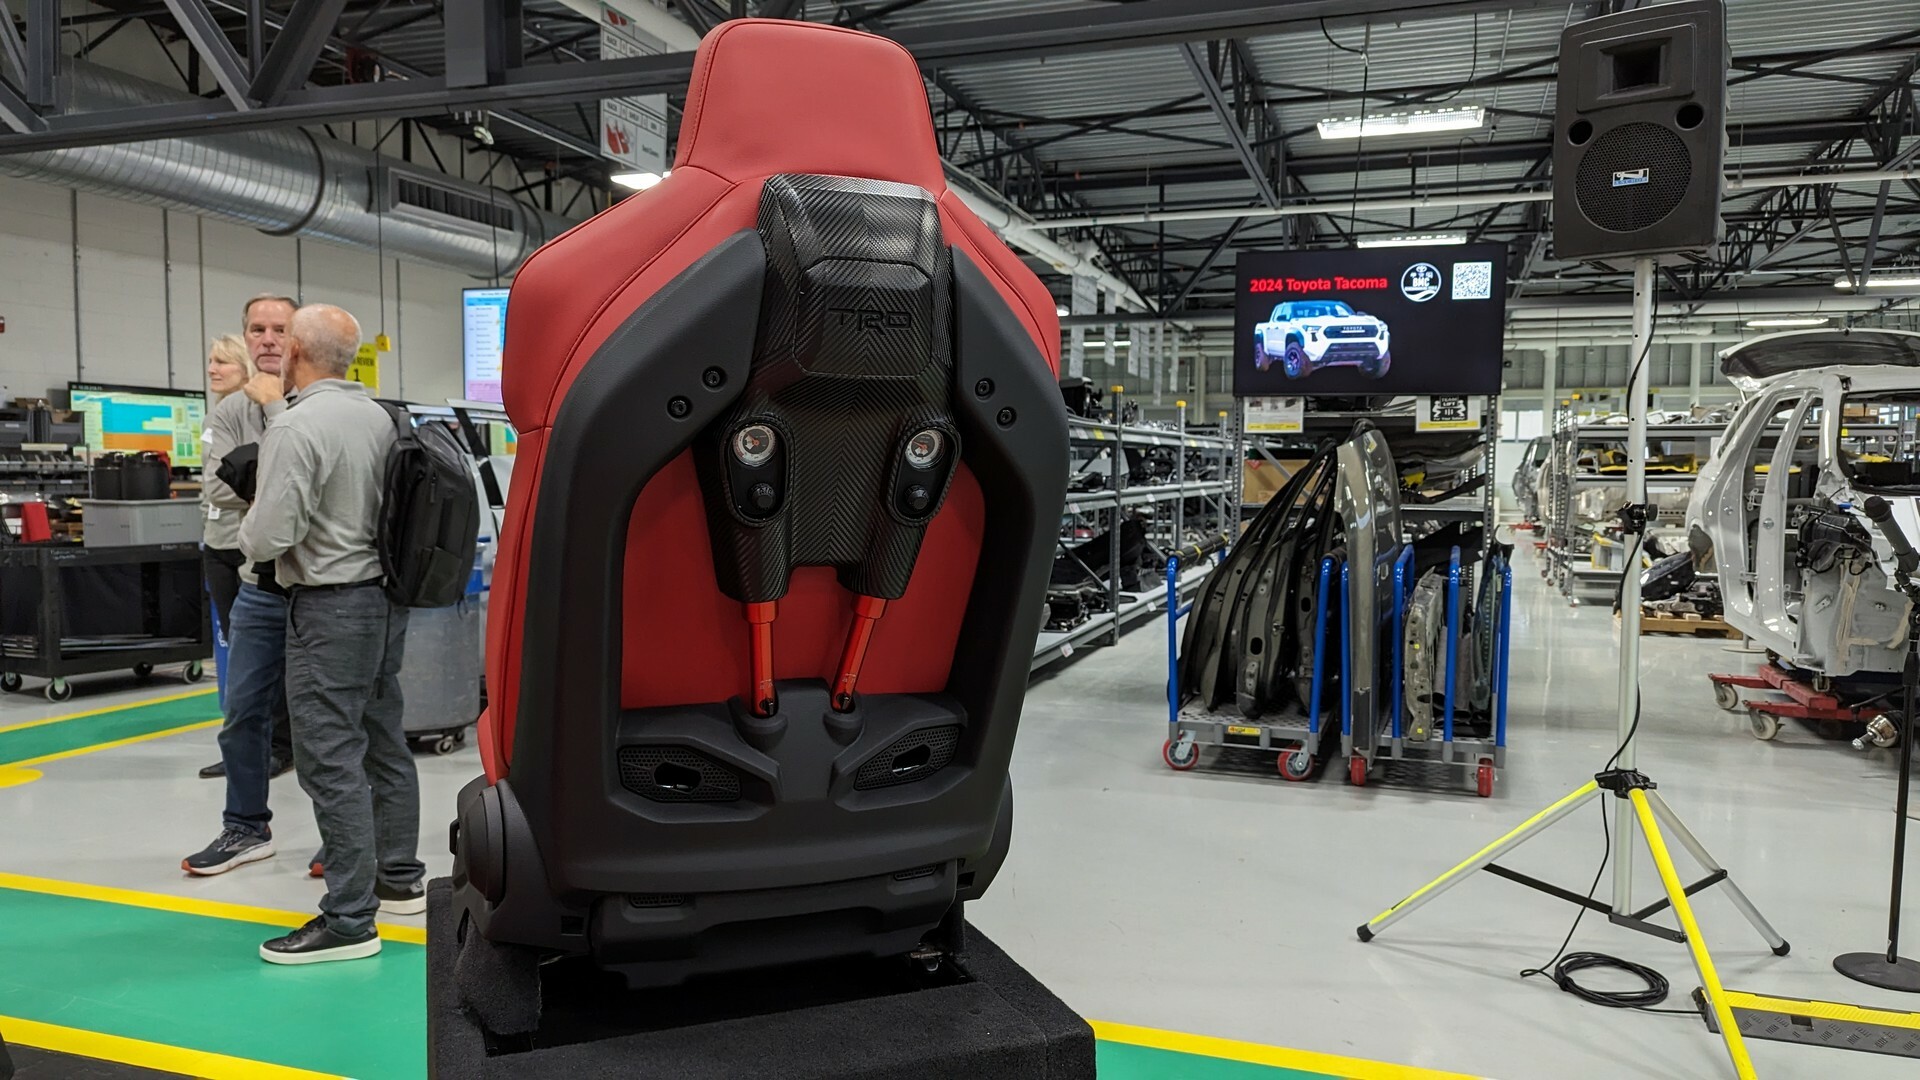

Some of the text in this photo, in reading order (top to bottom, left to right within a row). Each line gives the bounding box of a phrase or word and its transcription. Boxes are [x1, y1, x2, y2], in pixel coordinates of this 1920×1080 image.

[1249, 276, 1388, 294] 2024 Toyota Tacoma
[1412, 277, 1430, 288] BMC
[828, 307, 912, 336] TRD
